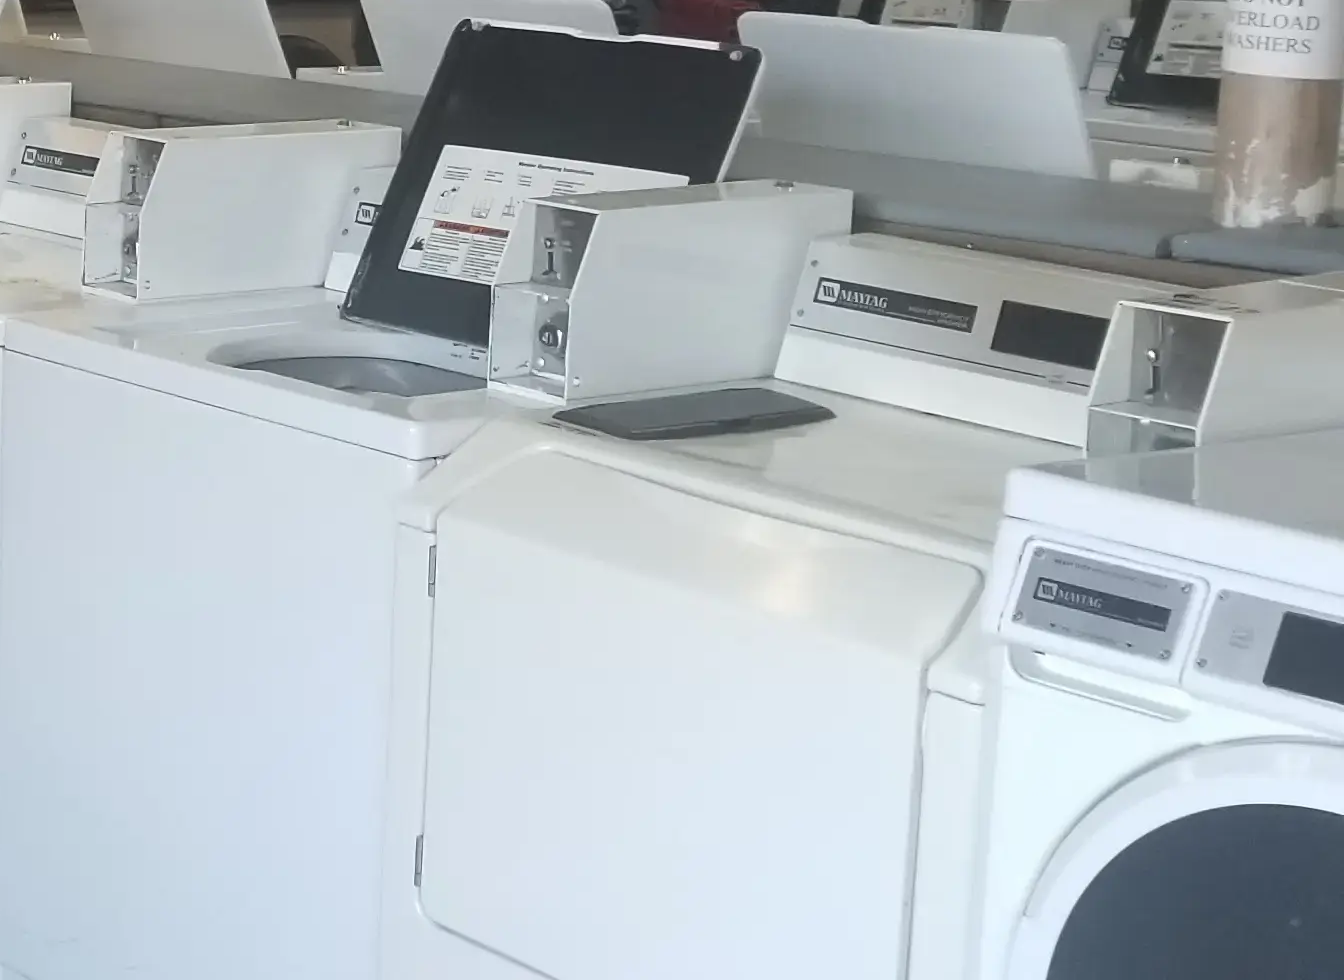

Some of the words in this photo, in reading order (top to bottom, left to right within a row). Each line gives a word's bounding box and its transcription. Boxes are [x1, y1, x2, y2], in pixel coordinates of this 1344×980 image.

[1237, 11, 1320, 31] ERLOAD
[839, 289, 889, 310] MAYTAG
[1057, 587, 1103, 609] MAYTAG
